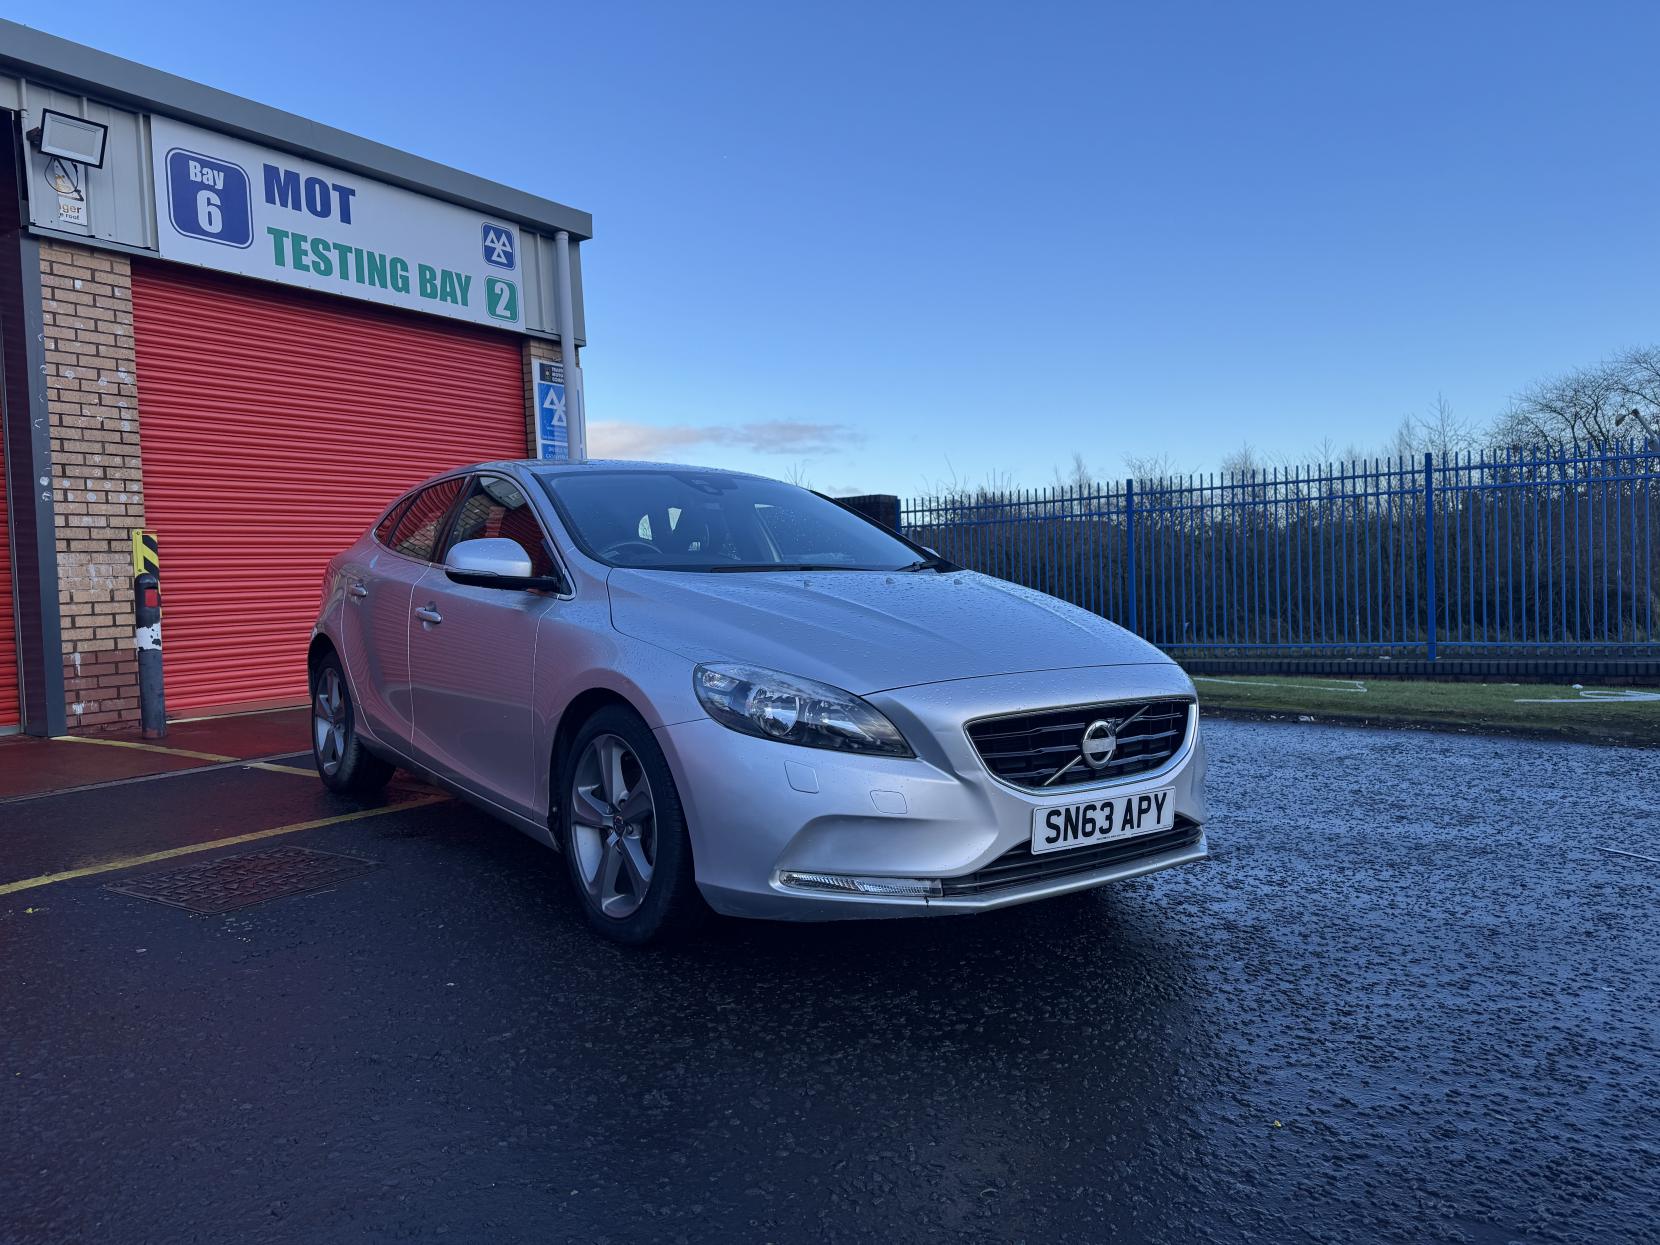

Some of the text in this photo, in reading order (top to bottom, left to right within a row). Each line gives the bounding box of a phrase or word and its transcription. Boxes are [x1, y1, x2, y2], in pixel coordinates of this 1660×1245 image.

[188, 160, 225, 190] Bay
[263, 163, 356, 225] MOT
[196, 189, 223, 234] 6
[267, 227, 472, 307] TESTING BAY
[495, 281, 511, 318] 2
[1045, 792, 1167, 844] SN63 APY
